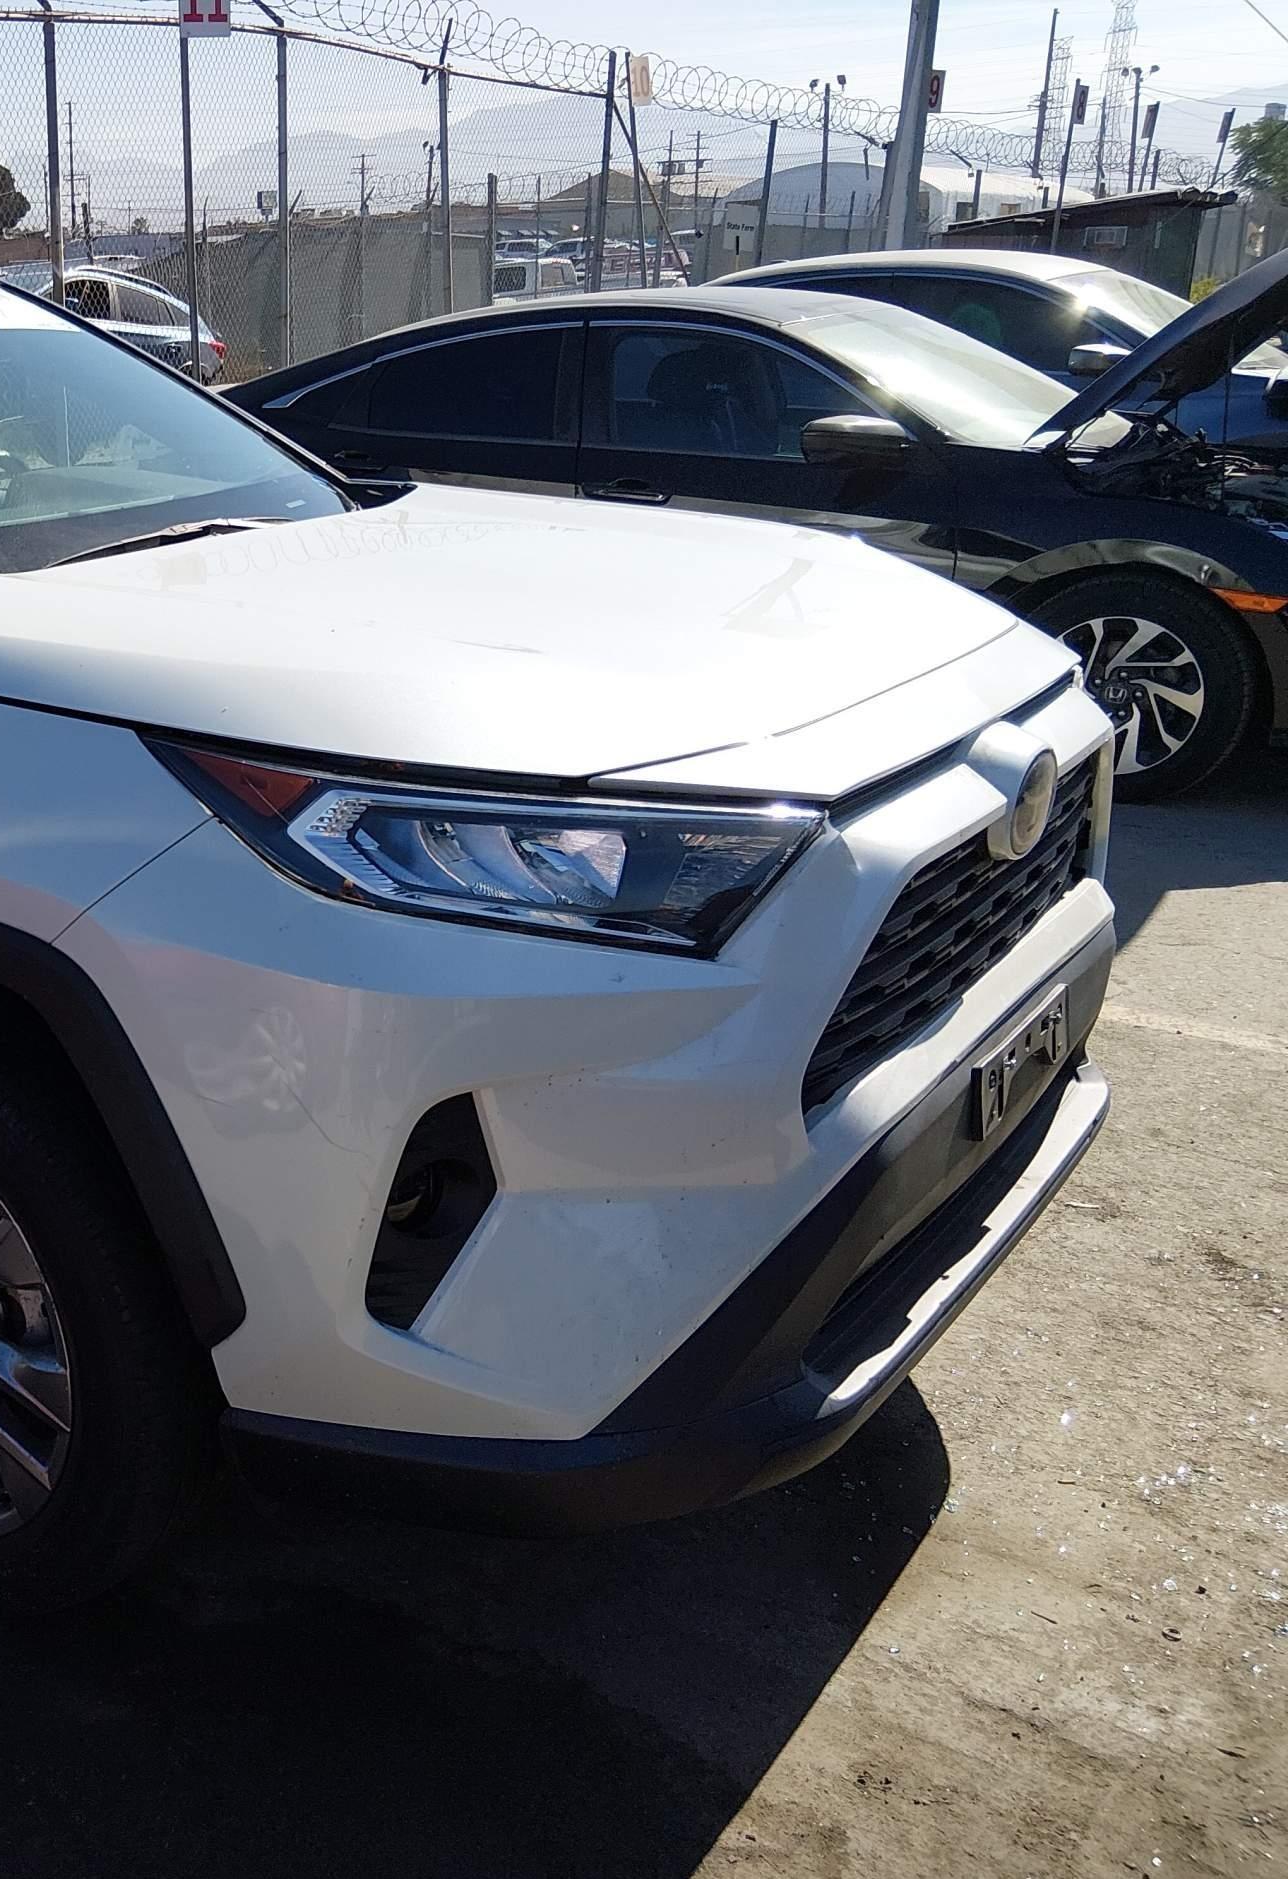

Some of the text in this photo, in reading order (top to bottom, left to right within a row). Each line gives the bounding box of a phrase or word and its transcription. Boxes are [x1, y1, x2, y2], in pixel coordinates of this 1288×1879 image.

[631, 65, 650, 97] 10
[928, 75, 940, 108] 9
[1076, 89, 1086, 120] 8
[726, 221, 755, 231] State Farm
